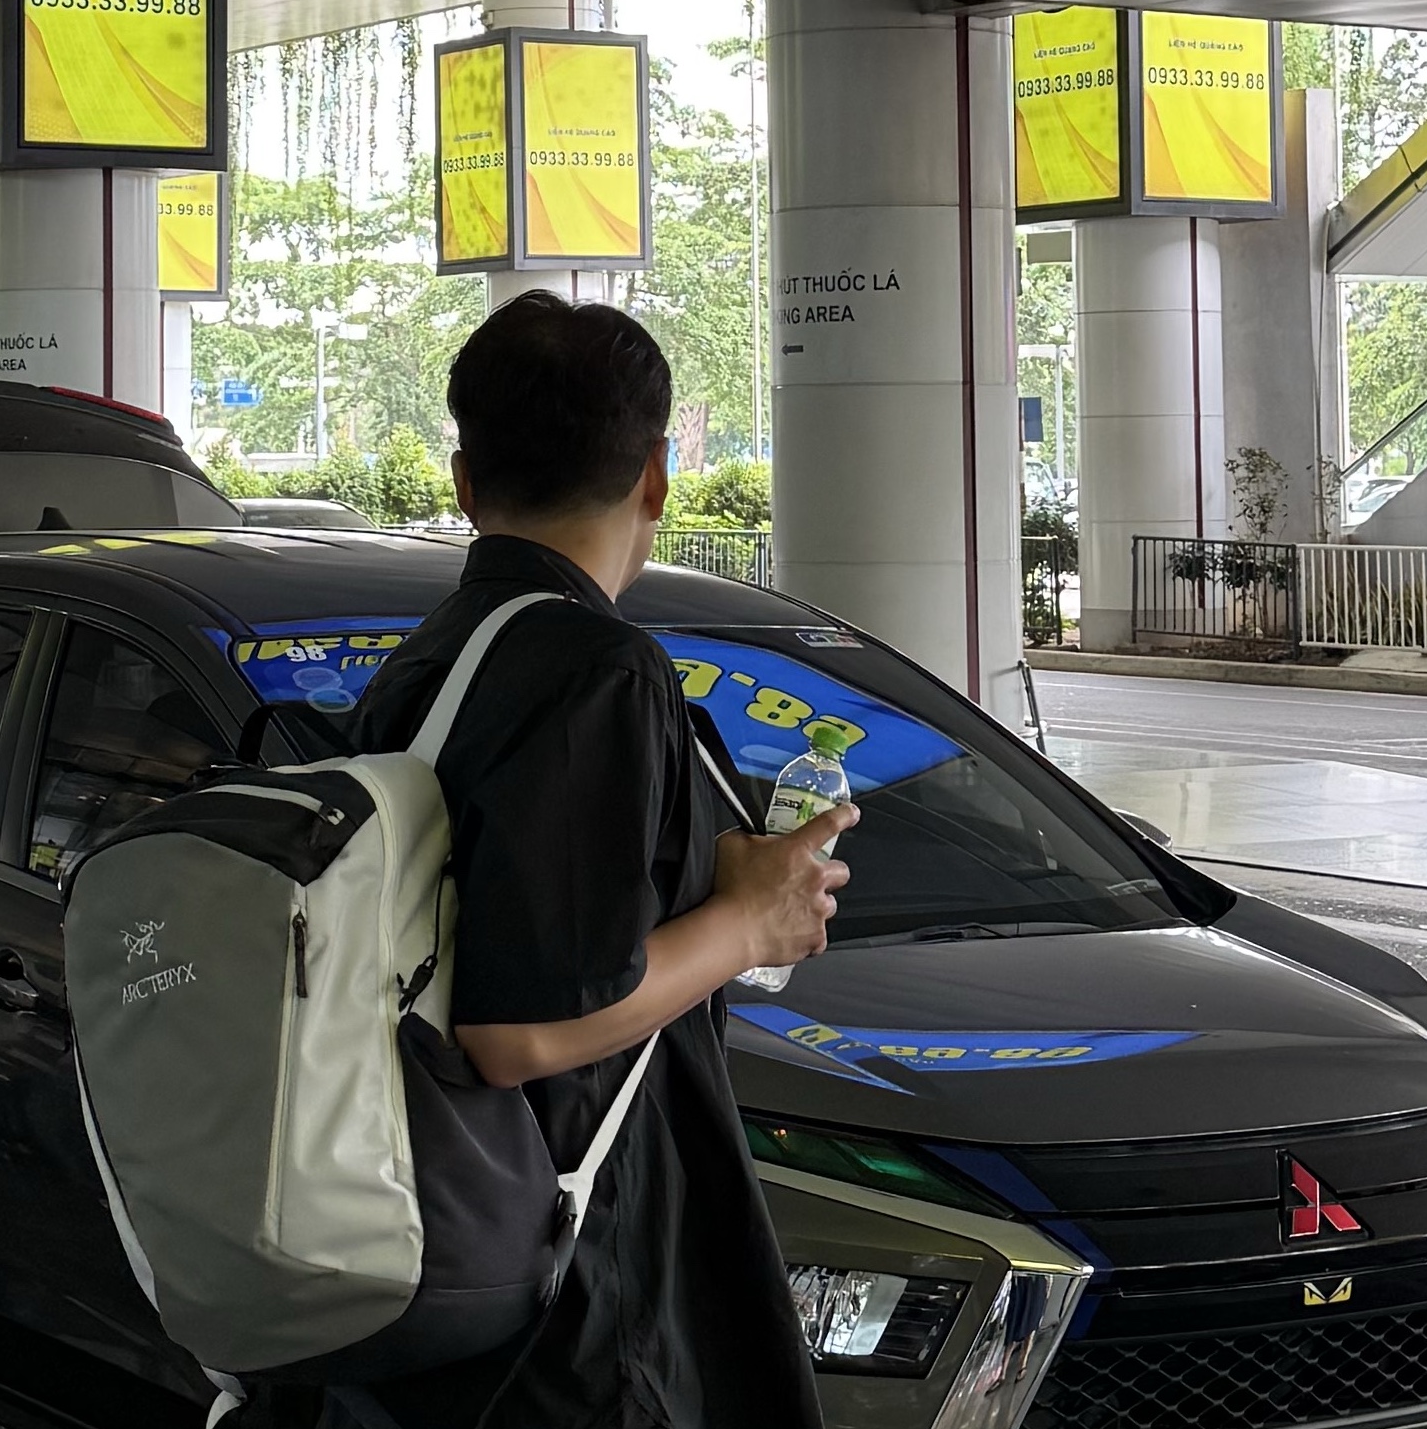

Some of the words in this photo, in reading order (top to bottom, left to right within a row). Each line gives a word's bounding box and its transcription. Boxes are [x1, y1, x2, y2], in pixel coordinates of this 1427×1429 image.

[1018, 68, 1114, 98] 0933.33.99.88
[1148, 66, 1265, 90] 0933.33.99.88
[529, 150, 634, 166] 0933.33.99.88
[802, 266, 866, 293] THUỐC
[873, 268, 900, 291] LÁ
[805, 305, 855, 324] AREA
[39, 333, 58, 349] LÁ
